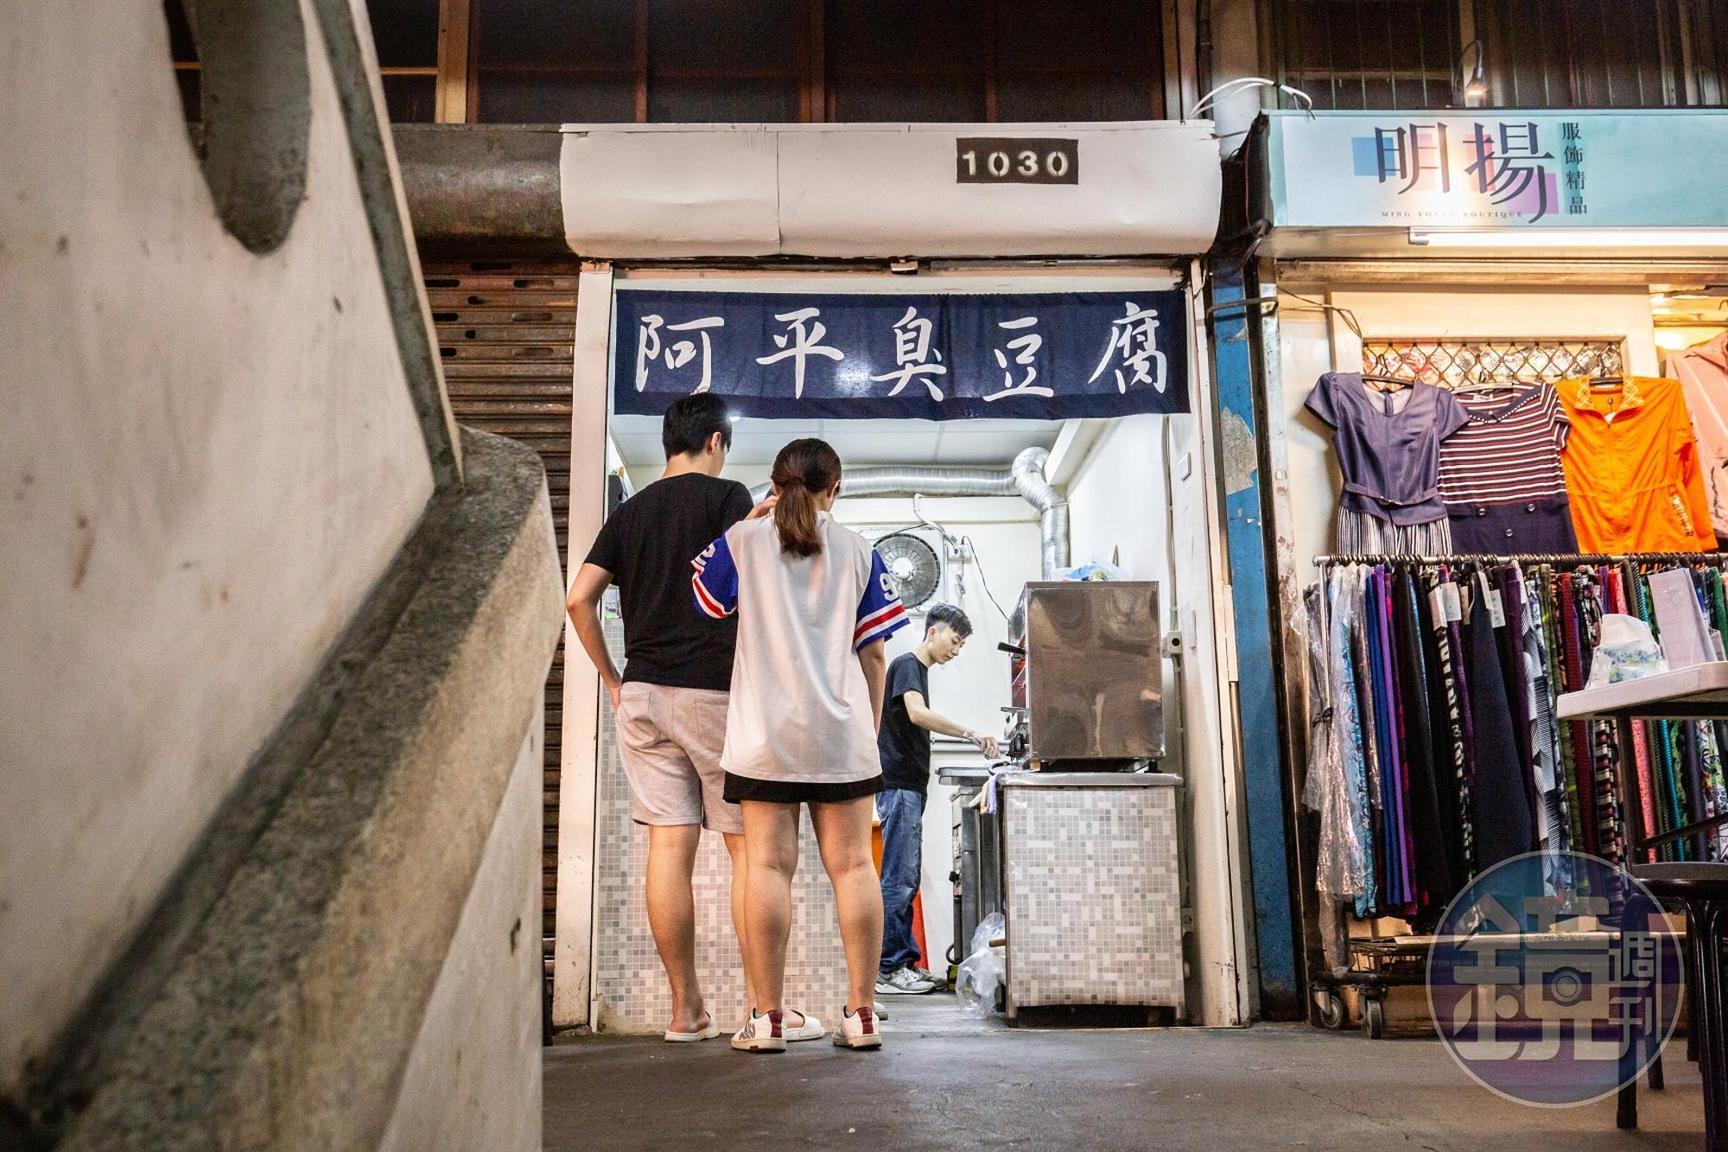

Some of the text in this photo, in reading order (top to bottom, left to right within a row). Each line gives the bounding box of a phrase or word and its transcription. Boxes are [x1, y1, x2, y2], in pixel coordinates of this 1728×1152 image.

[962, 150, 1069, 177] 1030
[1375, 122, 1555, 223] 明揚
[1562, 122, 1587, 215] 服飾精品
[635, 302, 1166, 402] 阿平臭豆腐
